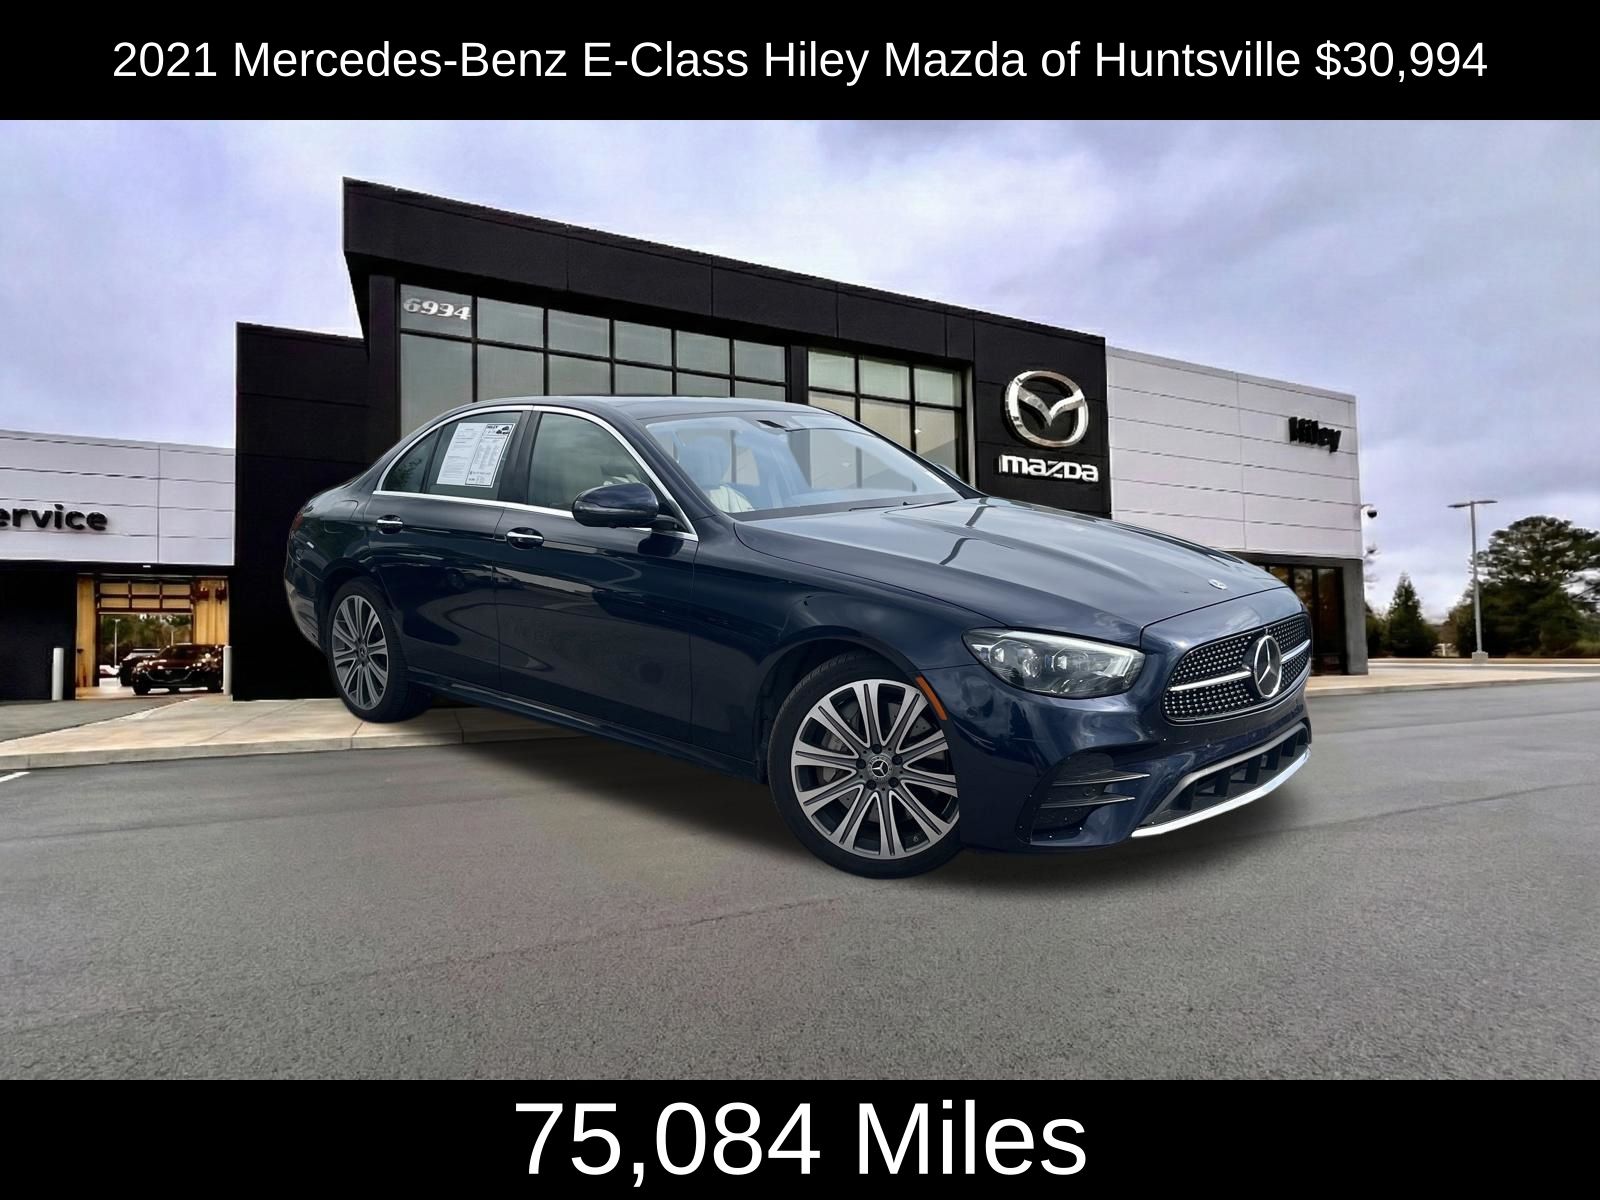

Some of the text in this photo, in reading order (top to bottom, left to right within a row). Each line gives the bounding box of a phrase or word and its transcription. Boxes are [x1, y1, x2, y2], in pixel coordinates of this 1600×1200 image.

[402, 297, 472, 321] 6934
[1288, 416, 1342, 453] Hiley
[998, 454, 1099, 482] mazda
